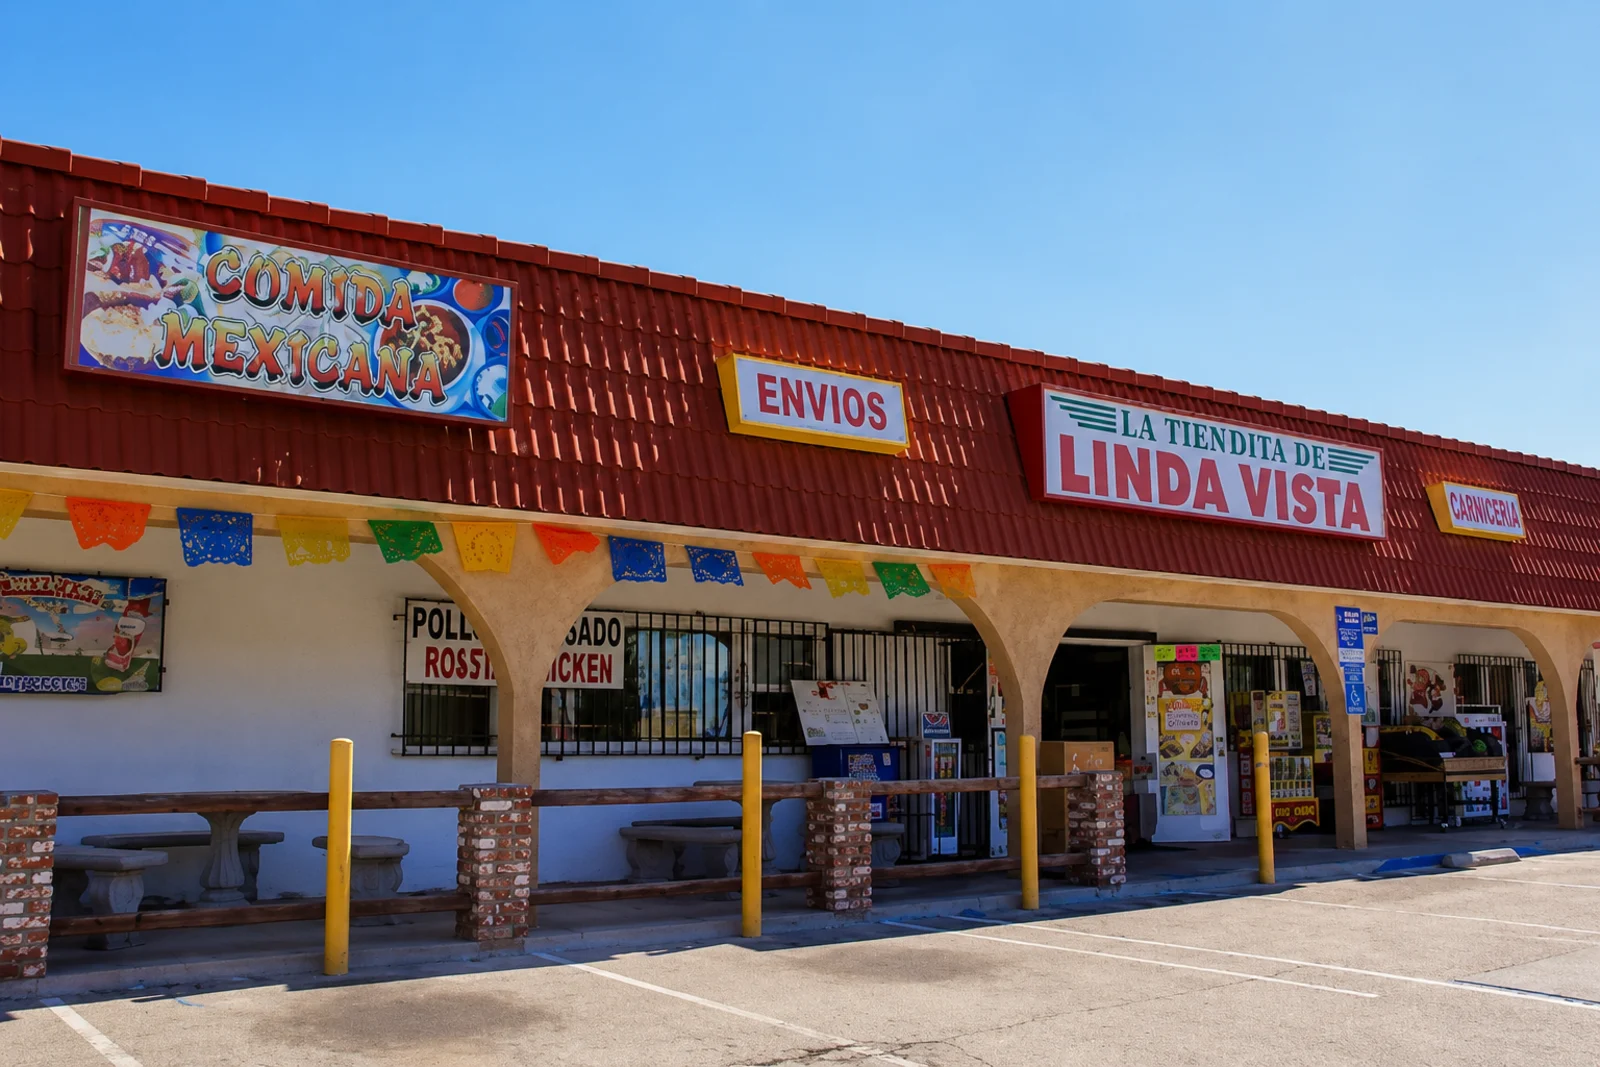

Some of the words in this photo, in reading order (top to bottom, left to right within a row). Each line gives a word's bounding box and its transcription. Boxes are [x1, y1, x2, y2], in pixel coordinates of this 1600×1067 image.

[206, 245, 417, 331] COMIDA
[154, 308, 448, 406] MEXICANA
[757, 373, 887, 431] ENVIOS
[1121, 409, 1157, 442] LA
[1164, 417, 1287, 463] TIENDITA
[1294, 441, 1325, 470] DE
[1059, 434, 1230, 513] LINDA
[1238, 463, 1371, 532] VISTA
[1450, 492, 1521, 528] CARNICERIA
[412, 606, 479, 641] POLL
[565, 616, 621, 647] SADO
[546, 651, 613, 684] ICKEN
